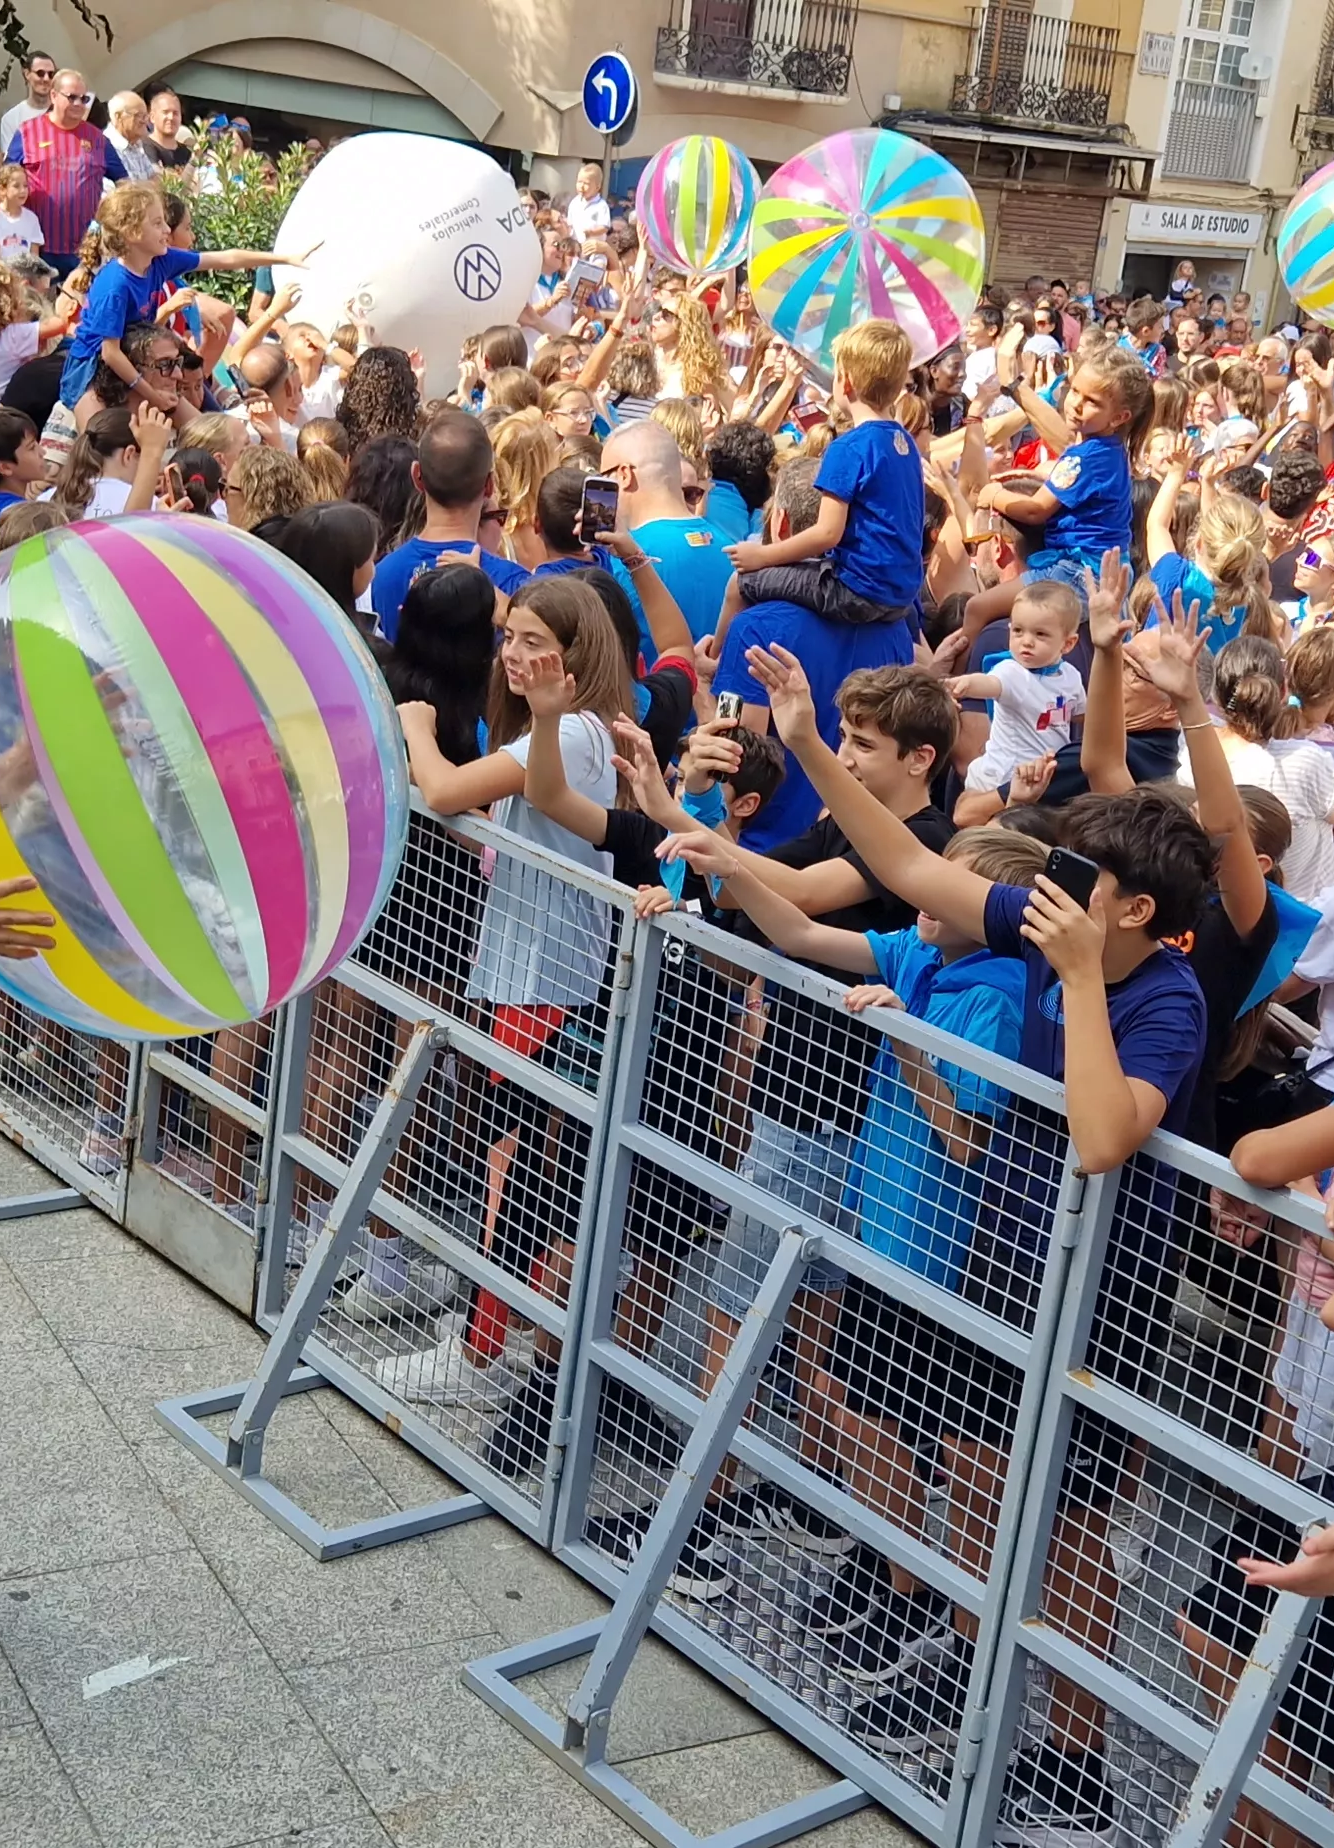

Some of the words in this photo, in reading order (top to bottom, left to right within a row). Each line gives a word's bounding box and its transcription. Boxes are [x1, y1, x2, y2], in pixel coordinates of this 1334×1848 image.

[418, 197, 481, 232] Comerciales
[1160, 211, 1188, 230] SALA
[1191, 214, 1205, 231] DE
[1206, 216, 1250, 234] ESTUDIO
